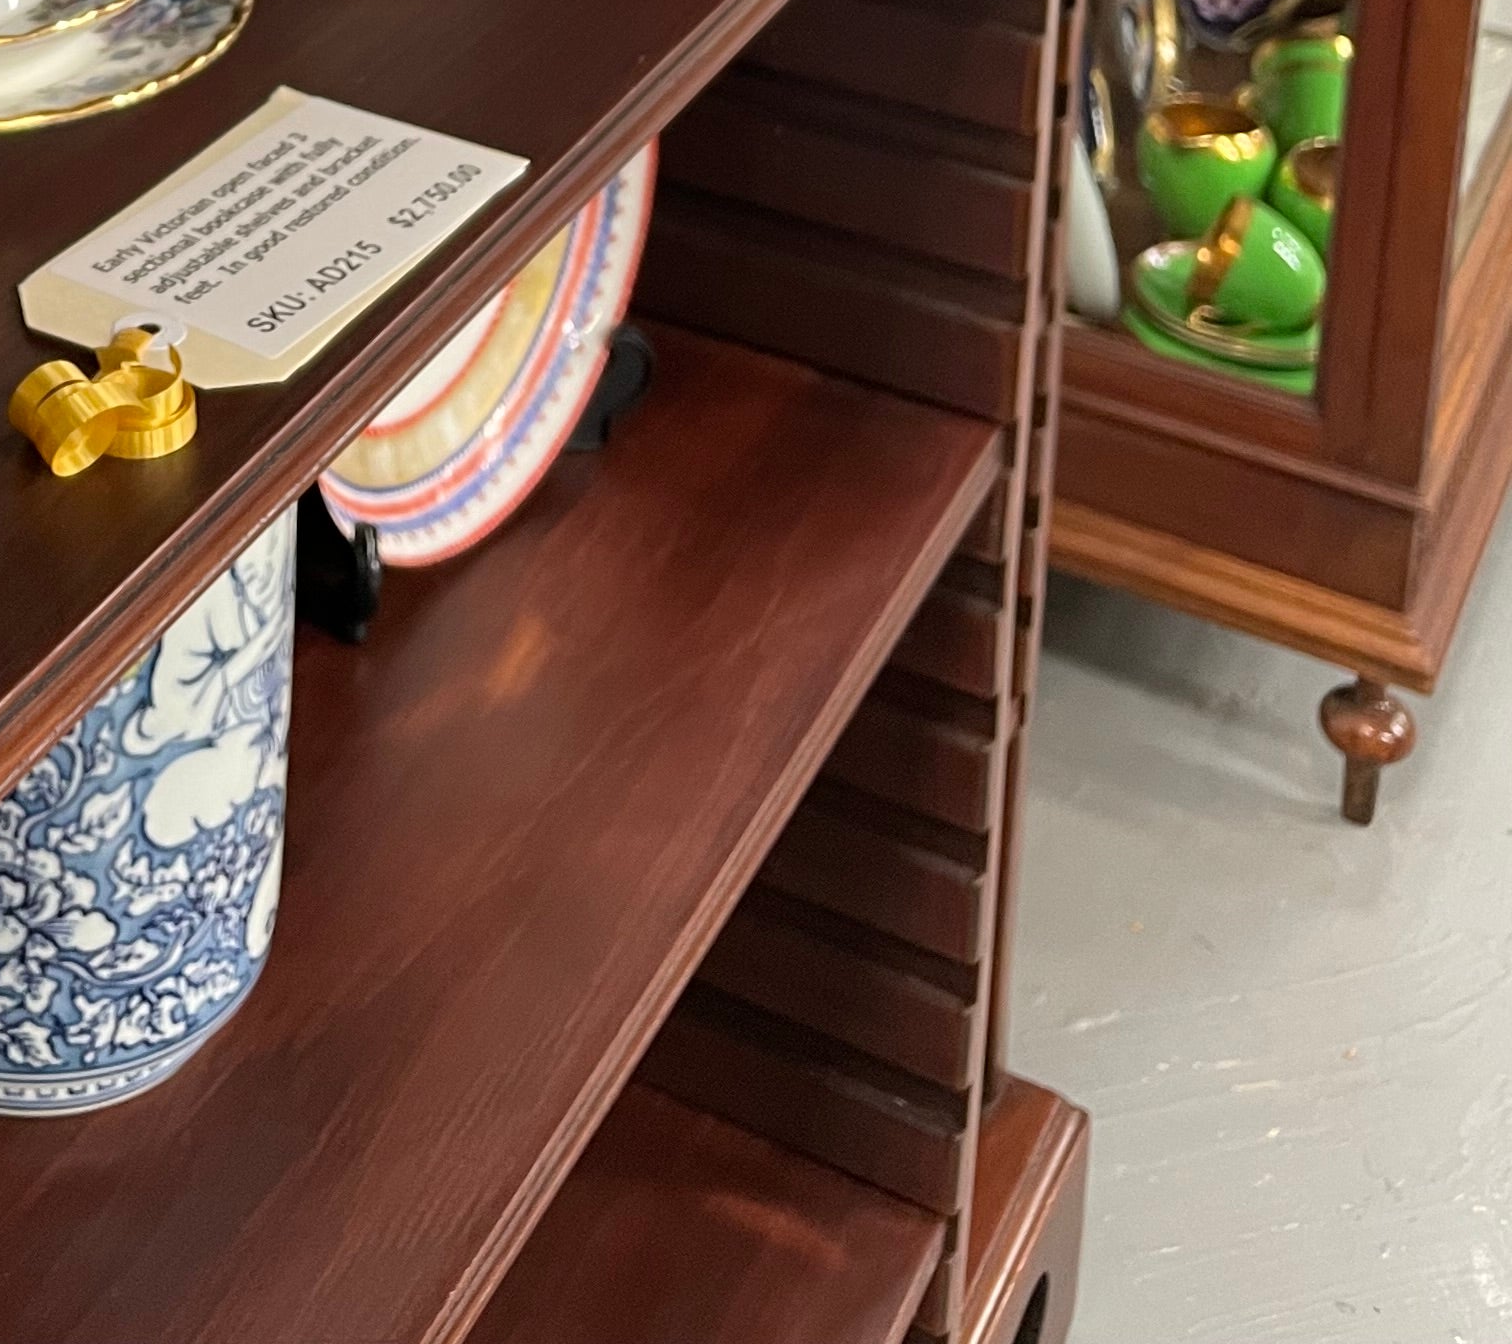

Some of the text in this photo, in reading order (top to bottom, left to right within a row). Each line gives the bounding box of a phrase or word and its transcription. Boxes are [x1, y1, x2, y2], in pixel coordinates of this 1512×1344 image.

[92, 242, 145, 273] Early
[135, 198, 216, 245] Victorian
[211, 170, 255, 198] open
[245, 141, 296, 171] faced
[123, 137, 344, 284] sectional bookcase with fully
[149, 136, 383, 294] adjustable shelves and bracket
[173, 137, 422, 305] feet. In good restored condition.
[246, 163, 482, 332] SKU: AD215 $2,750.00
